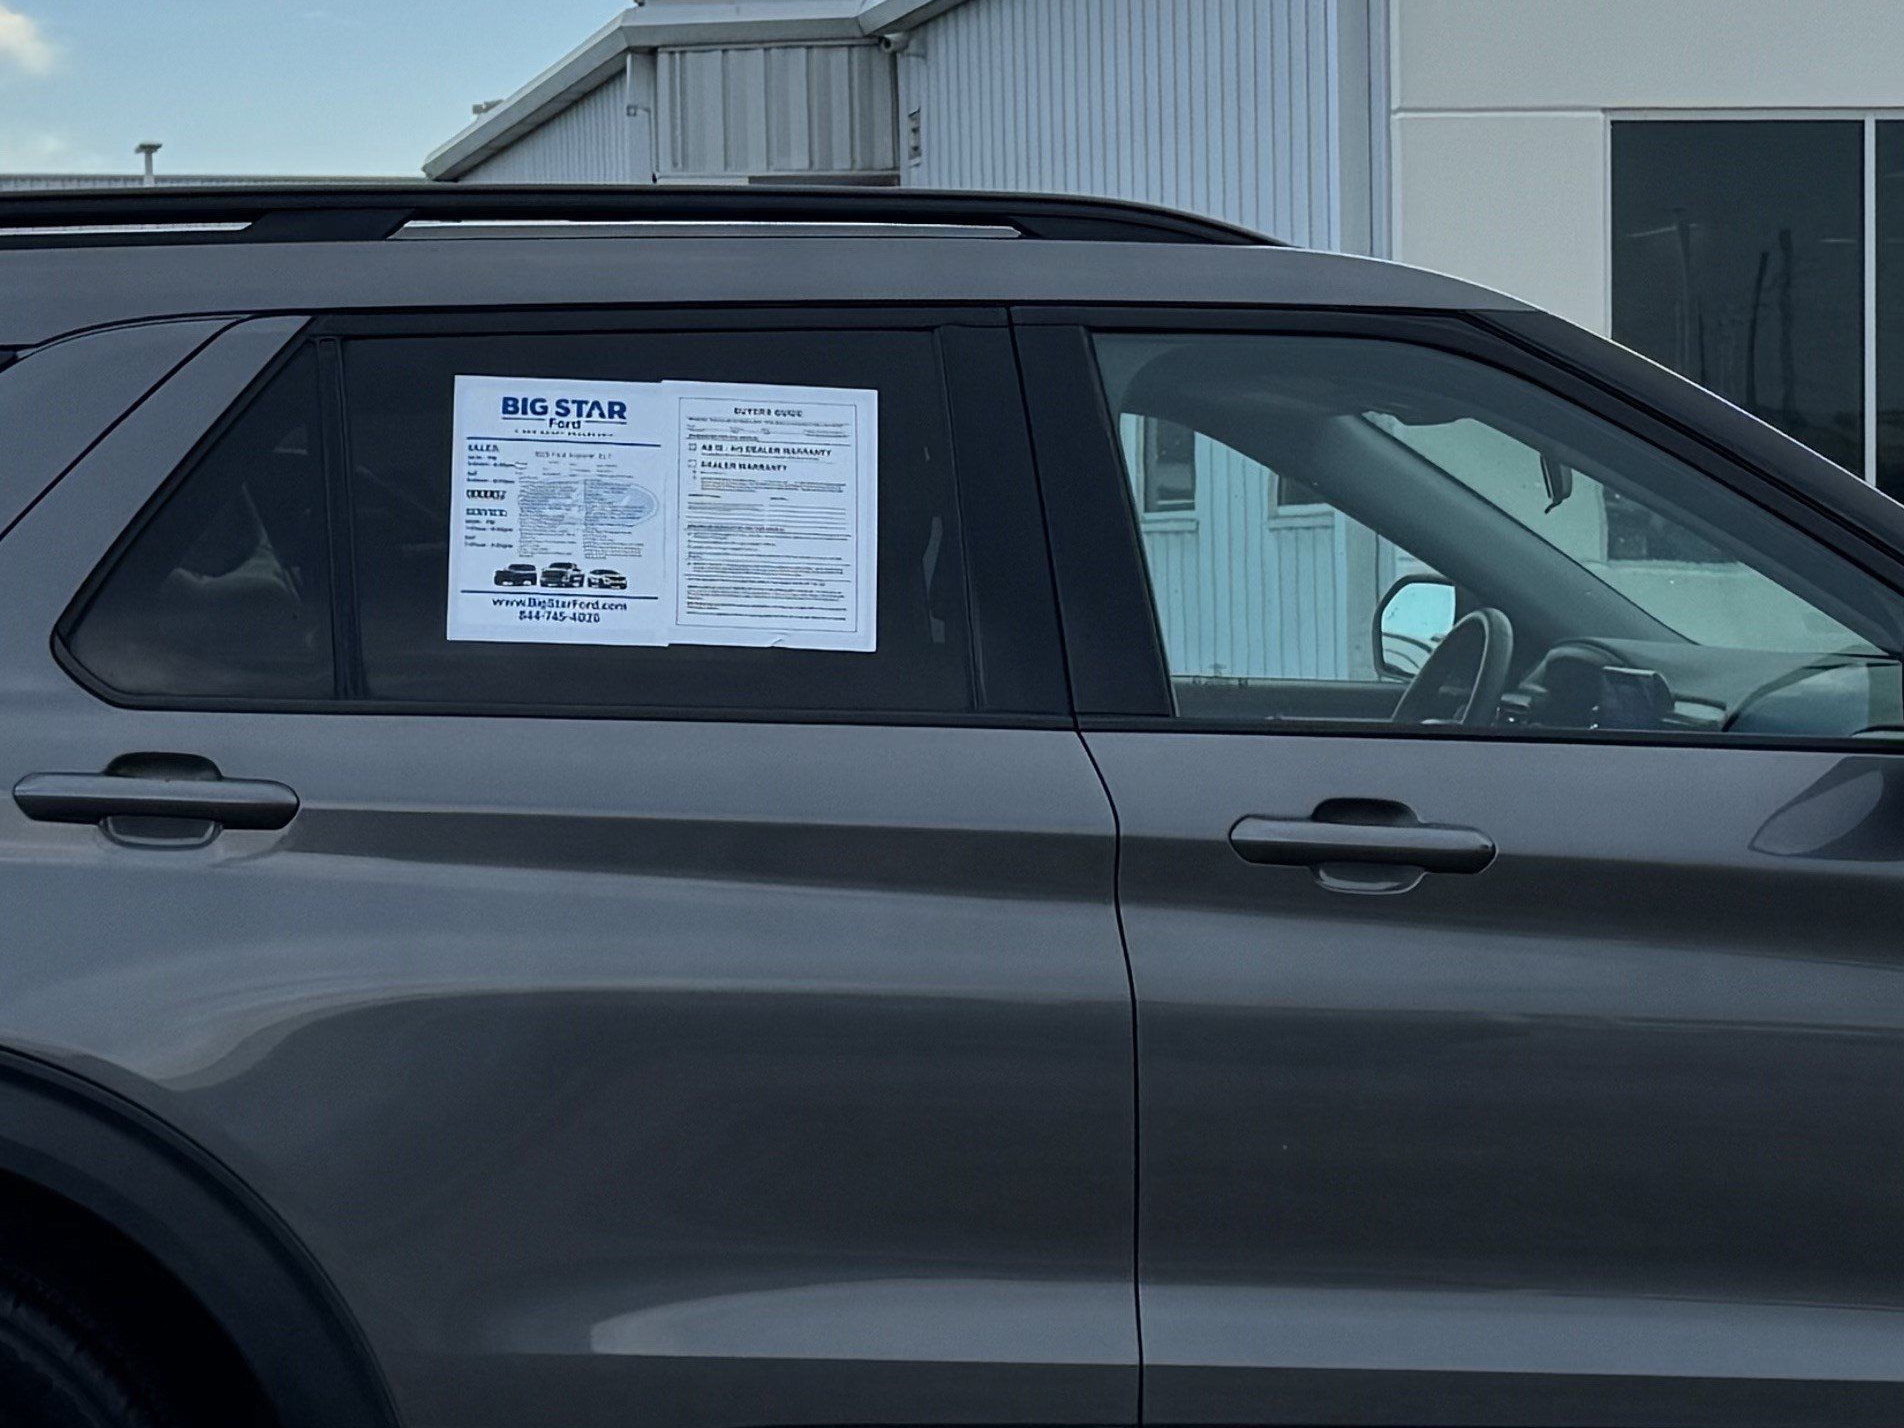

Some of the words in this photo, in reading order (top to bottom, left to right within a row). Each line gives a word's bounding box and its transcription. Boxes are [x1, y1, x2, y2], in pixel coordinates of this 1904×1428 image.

[501, 397, 548, 416] BIG
[555, 399, 627, 420] STAR
[549, 417, 581, 429] Ford
